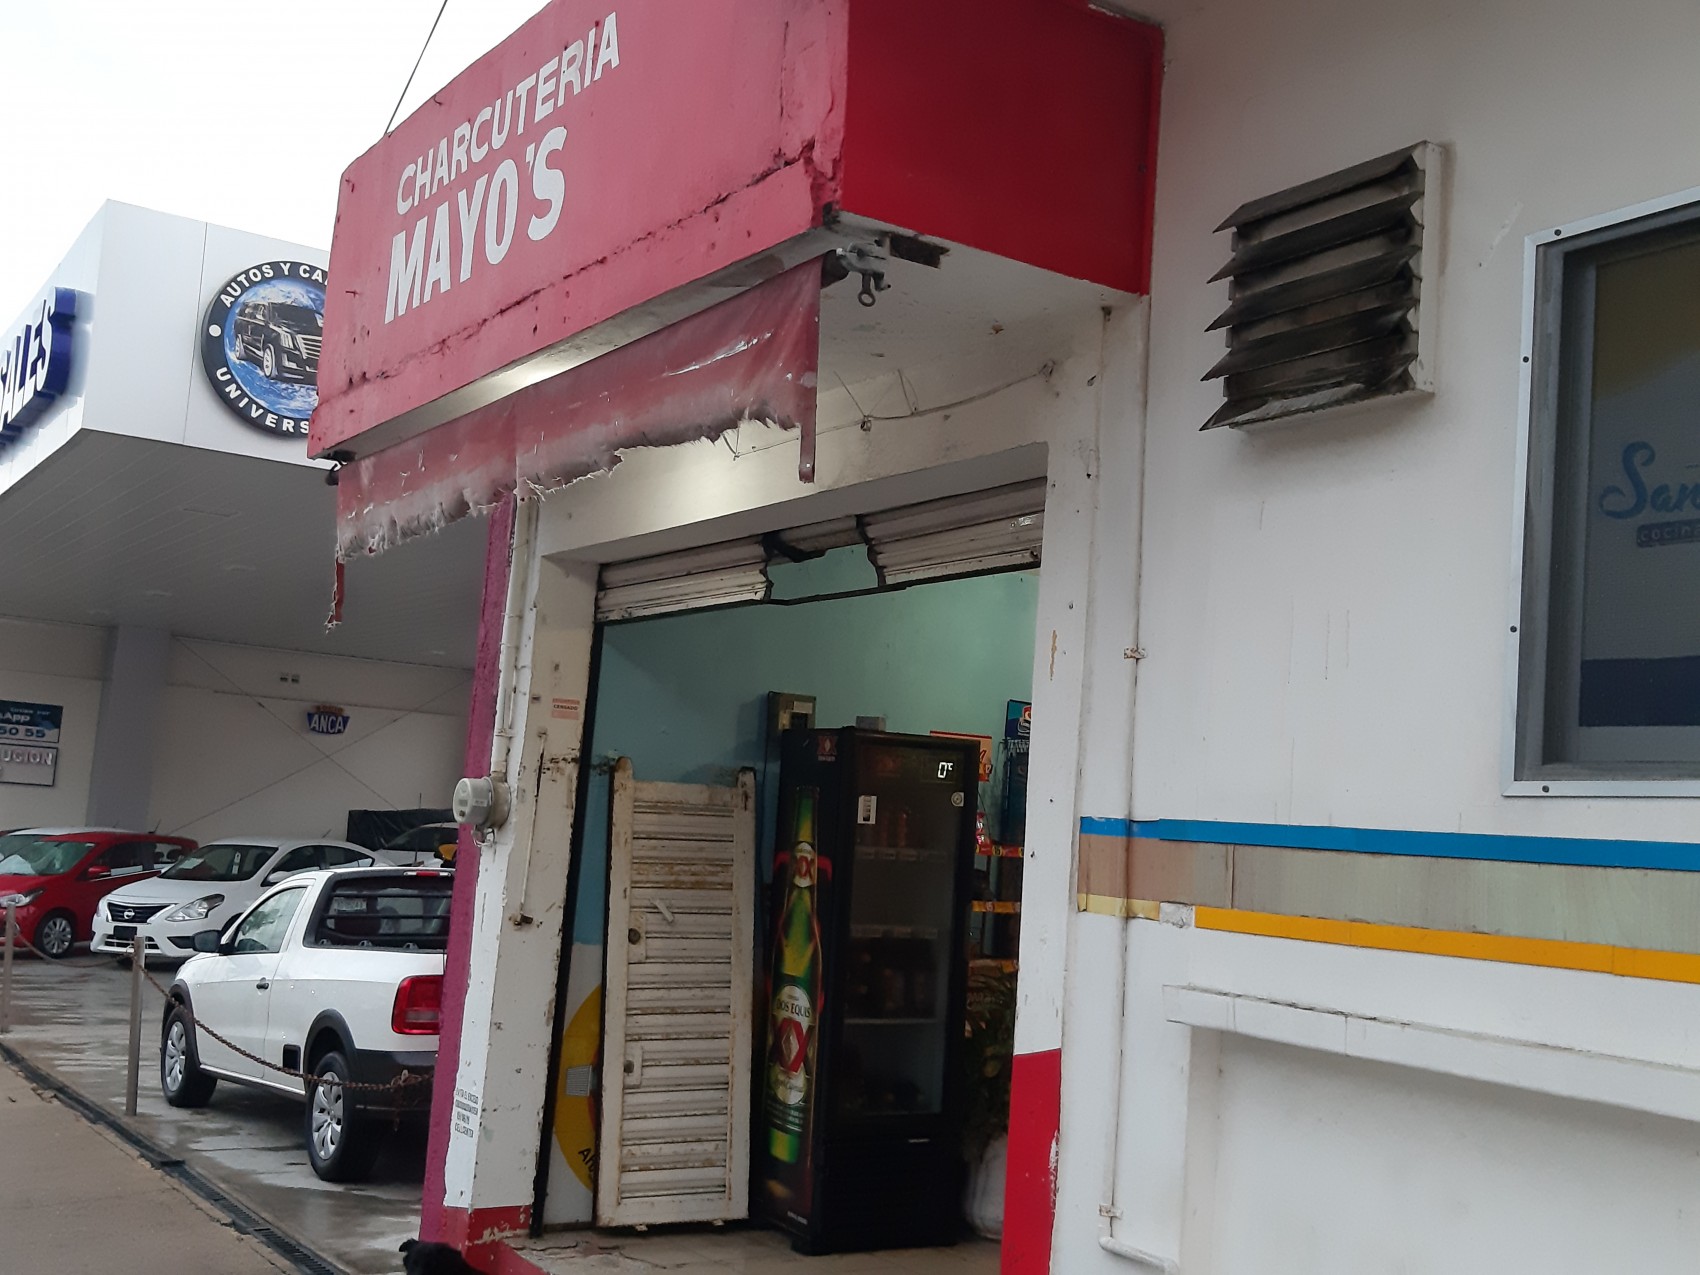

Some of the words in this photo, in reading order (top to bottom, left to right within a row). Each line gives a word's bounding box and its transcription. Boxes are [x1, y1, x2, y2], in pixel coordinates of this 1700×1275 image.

[396, 11, 621, 216] CHARCUTERIA
[220, 263, 274, 308] AUTOS
[280, 262, 292, 276] Y
[298, 264, 328, 286] CA
[384, 126, 568, 325] MAYO'S
[310, 713, 343, 734] ANCA
